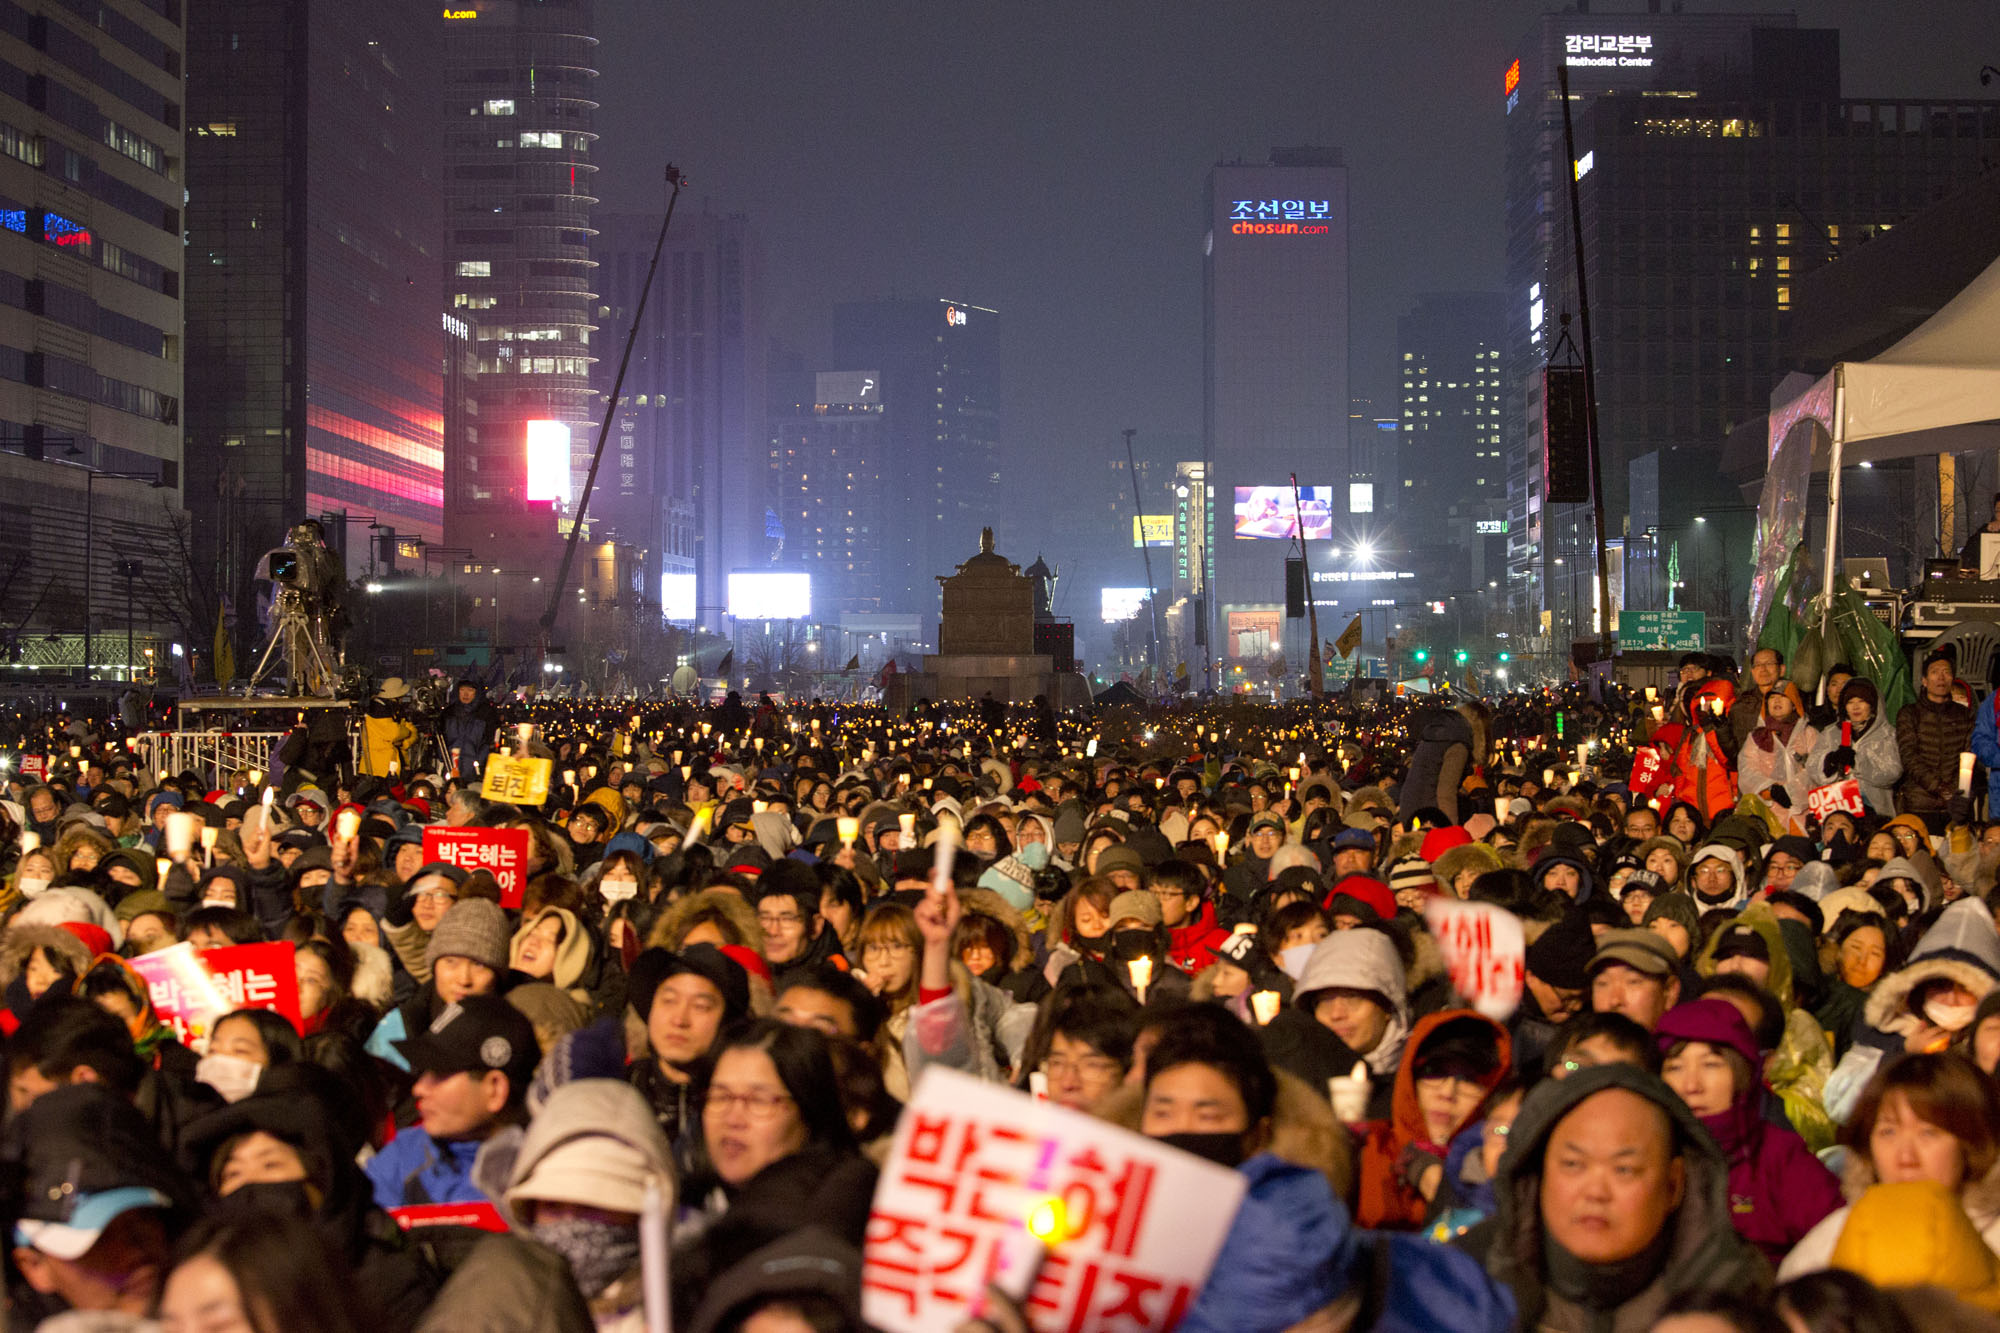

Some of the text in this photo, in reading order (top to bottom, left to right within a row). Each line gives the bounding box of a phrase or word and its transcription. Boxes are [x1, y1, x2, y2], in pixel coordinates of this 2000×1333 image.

[1565, 34, 1653, 53] 감리교본부
[1565, 56, 1653, 66] Methodist Center
[1229, 199, 1333, 220] 조선일보
[1231, 220, 1329, 235] chosun.com
[1179, 501, 1188, 579] 서울특별시의회
[488, 775, 529, 799] 퇴진
[437, 842, 518, 867] 박근혜는
[901, 1113, 1157, 1259] 박근혜
